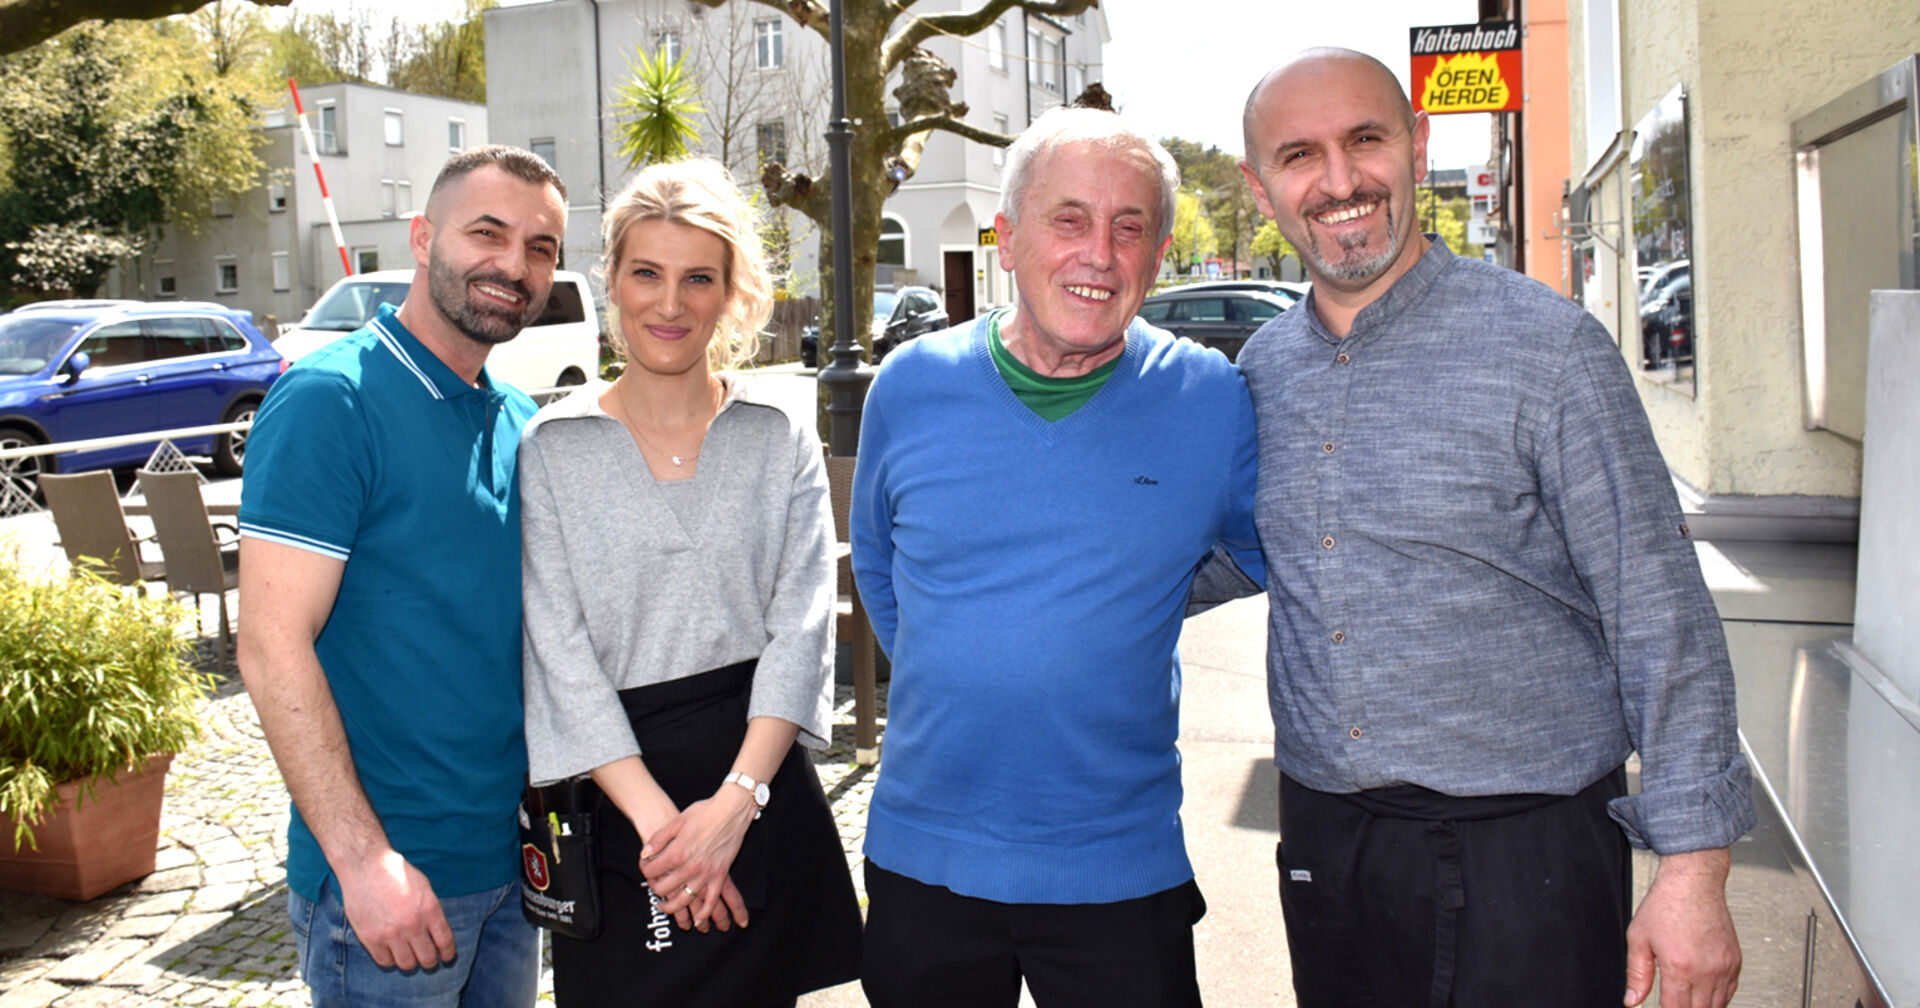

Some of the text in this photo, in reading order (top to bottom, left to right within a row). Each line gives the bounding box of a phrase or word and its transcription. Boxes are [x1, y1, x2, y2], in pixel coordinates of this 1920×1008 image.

[1412, 23, 1518, 54] Kaltenbach
[1436, 67, 1494, 88] ÖFEN
[1428, 87, 1501, 107] HERDE
